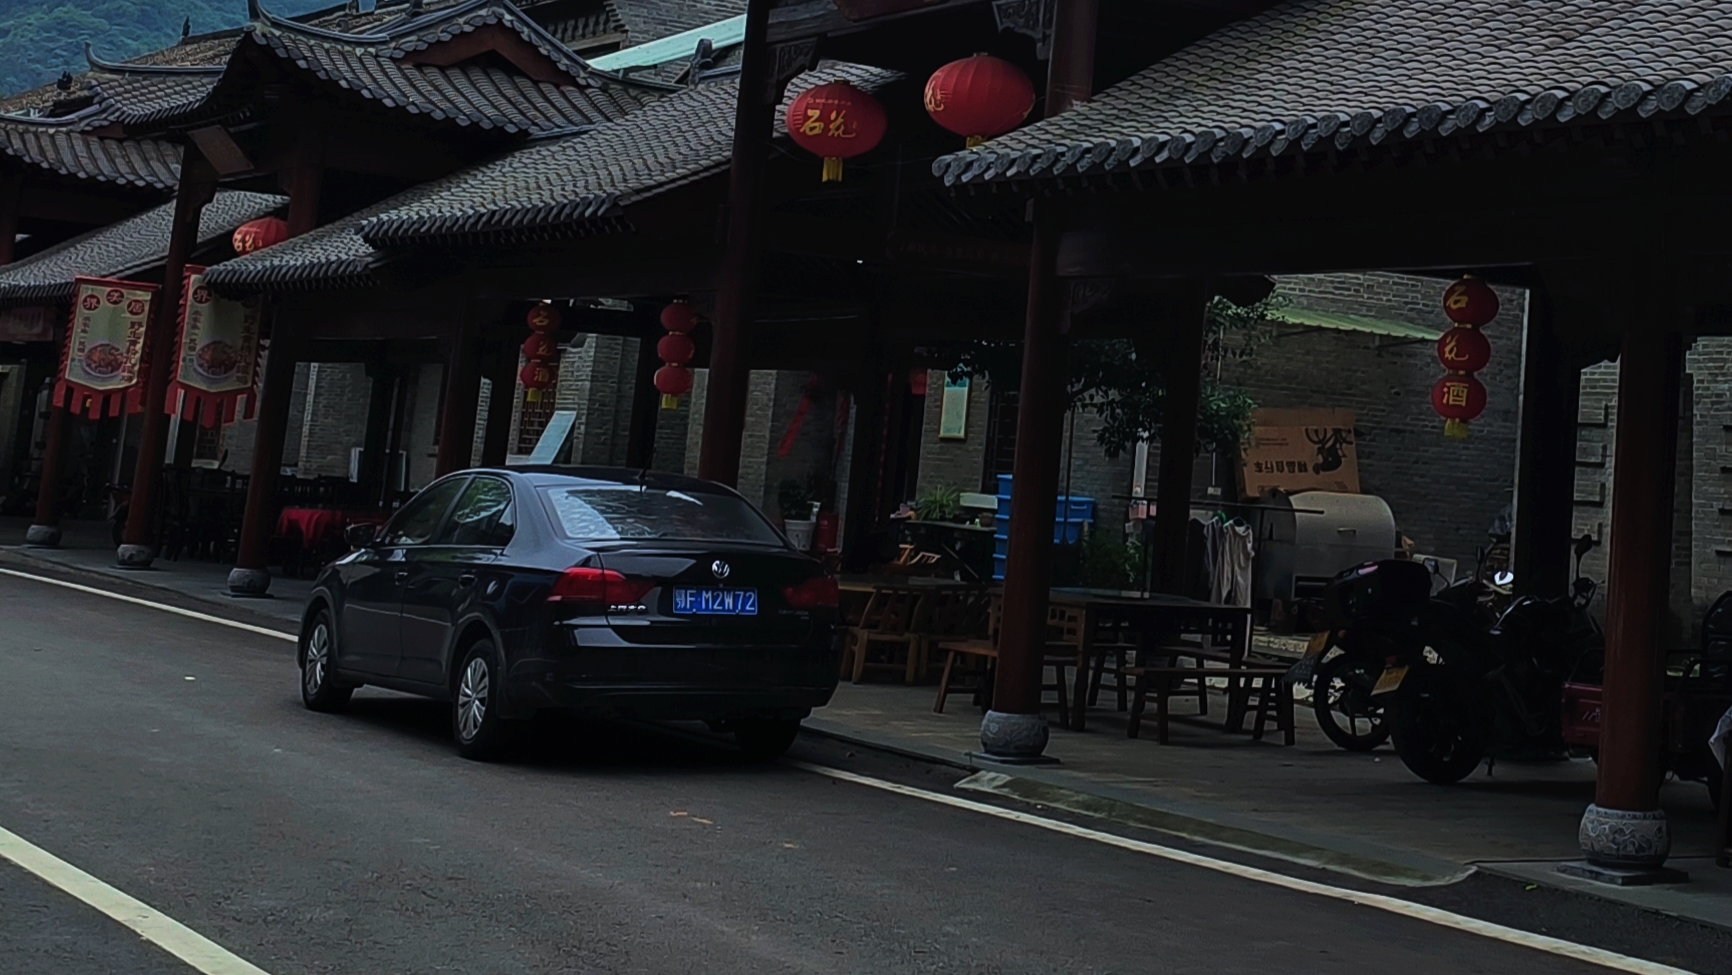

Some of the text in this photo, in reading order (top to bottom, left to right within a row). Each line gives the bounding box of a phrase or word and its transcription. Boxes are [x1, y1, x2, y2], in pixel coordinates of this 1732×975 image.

[800, 108, 857, 138] 石花
[1442, 285, 1469, 407] 石花酒
[1253, 460, 1308, 474] 精品自行车
